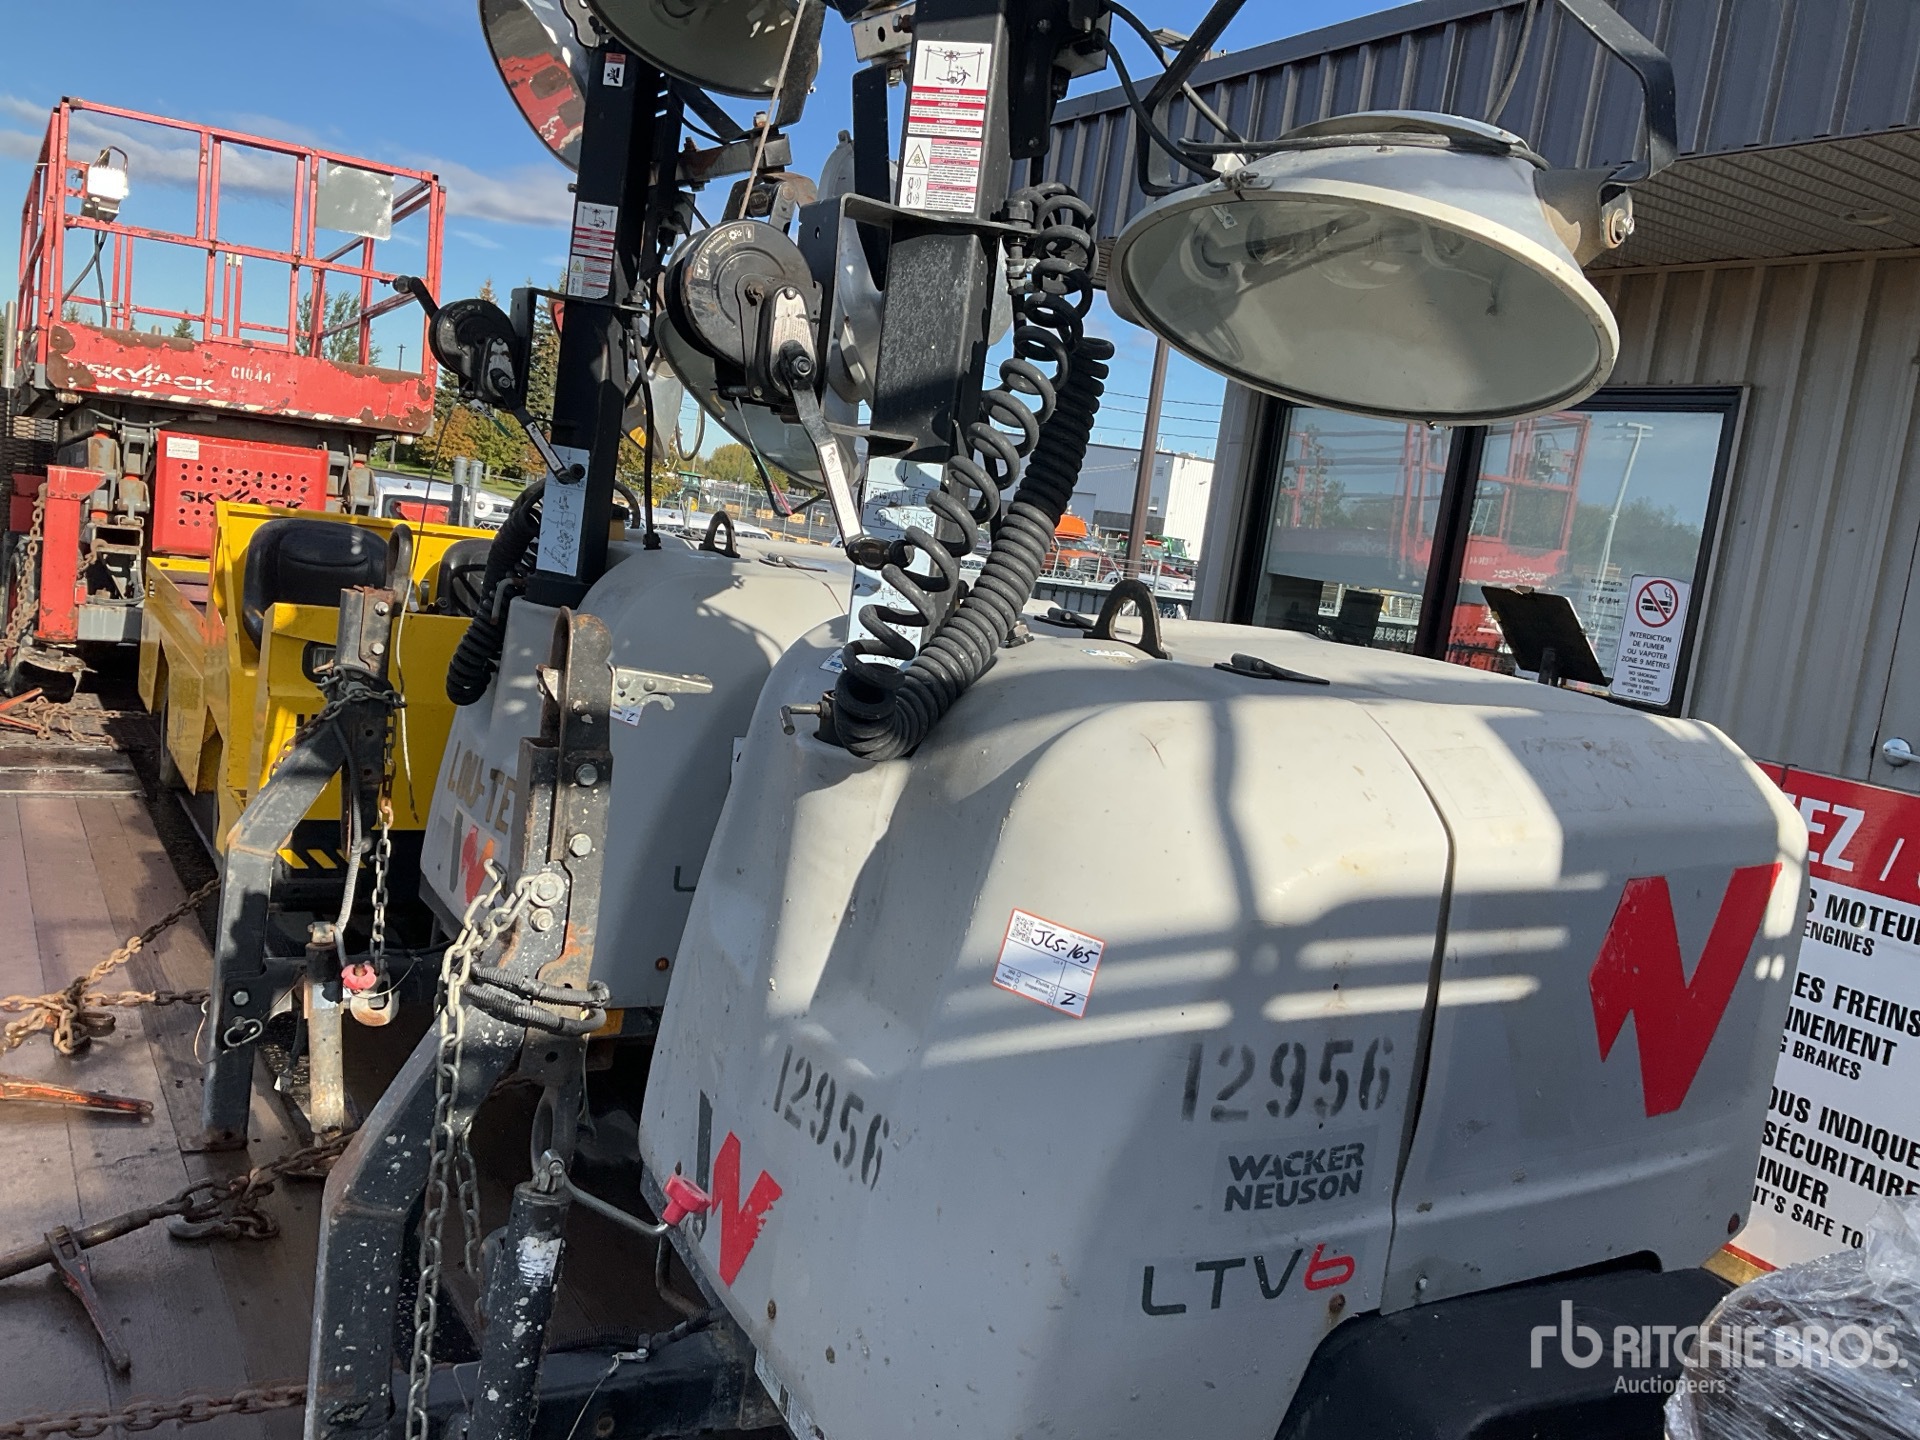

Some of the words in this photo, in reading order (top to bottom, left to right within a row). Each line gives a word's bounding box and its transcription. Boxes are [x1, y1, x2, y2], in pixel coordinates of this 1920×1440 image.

[87, 363, 215, 393] SKYJACK
[1626, 648, 1637, 656] OU
[1640, 650, 1668, 660] VAPOTER
[1629, 631, 1672, 643] INTERDICTION
[1632, 640, 1642, 648] DE
[1643, 642, 1664, 651] FUMER
[1621, 656, 1638, 664] ZONE
[1782, 792, 1865, 872] EZ
[1832, 985, 1920, 1037] FREINS
[1181, 1037, 1394, 1123] 12956
[1792, 1040, 1862, 1081] BRAKES
[773, 1044, 890, 1192] 12956
[1227, 1142, 1365, 1182] WACKER
[1224, 1170, 1363, 1212] NEUSON
[1790, 1203, 1835, 1237] SAFE
[1141, 1243, 1355, 1316] LTV6
